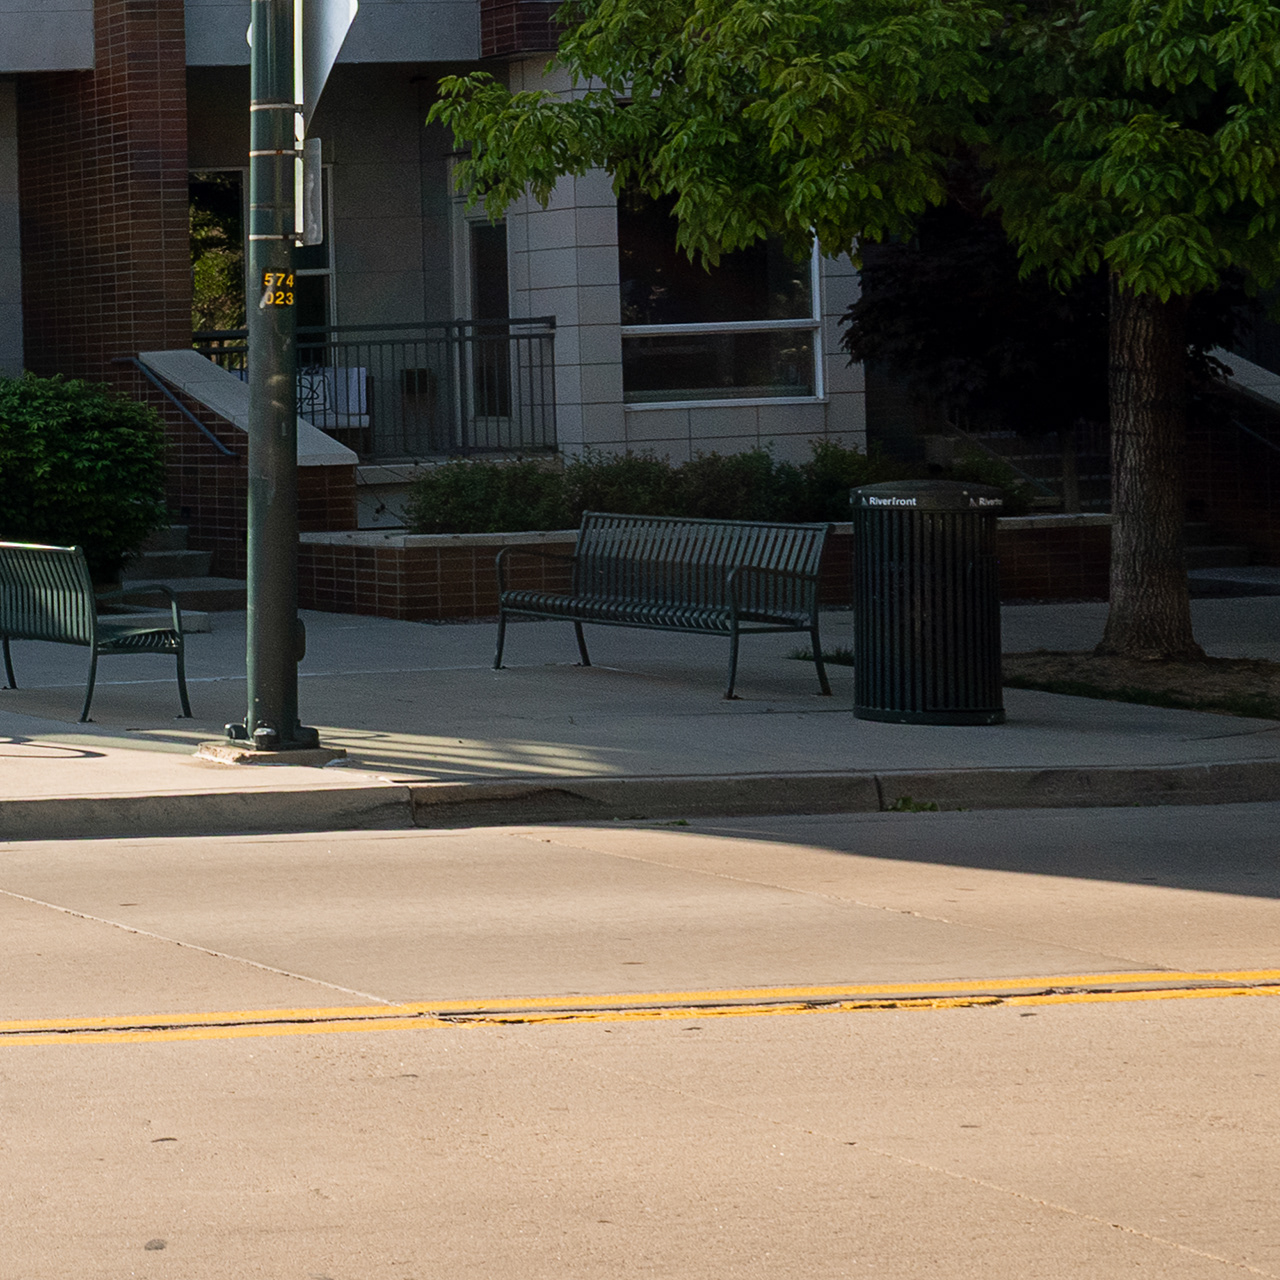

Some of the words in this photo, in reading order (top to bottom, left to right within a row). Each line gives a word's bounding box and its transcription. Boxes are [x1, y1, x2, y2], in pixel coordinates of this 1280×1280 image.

[264, 273, 294, 287] 574
[265, 291, 294, 305] 023
[869, 497, 917, 506] Riverfront
